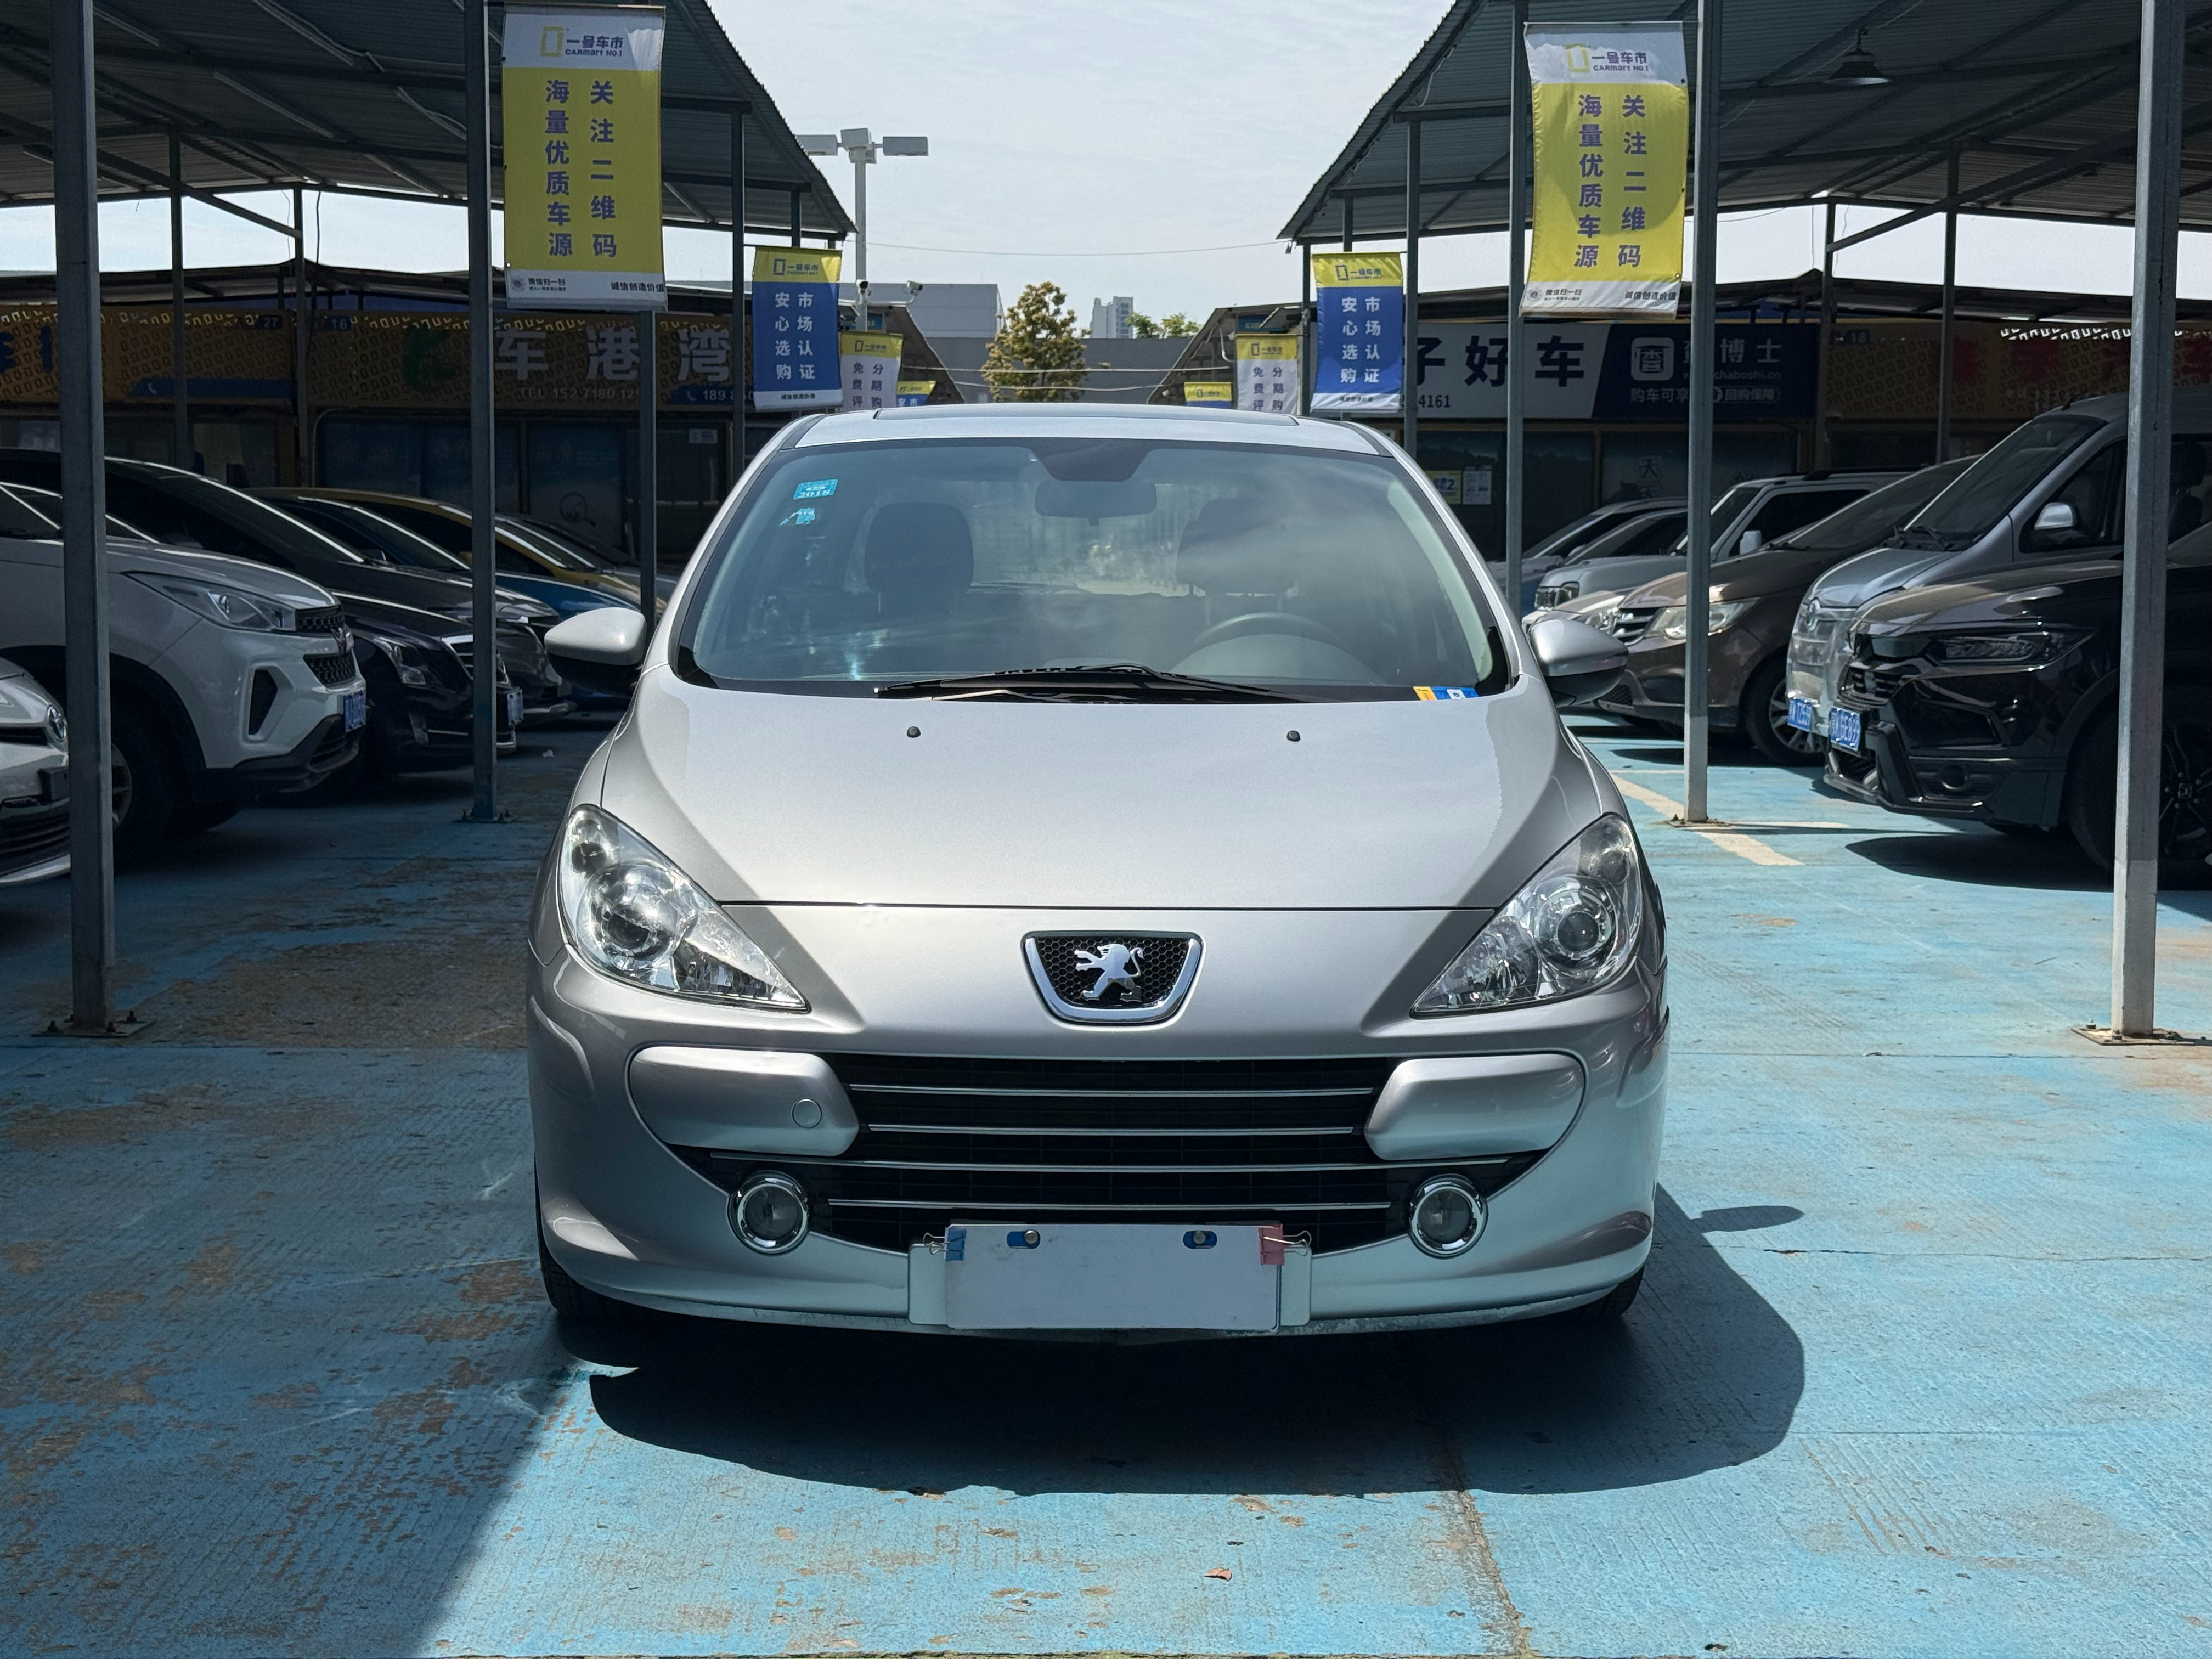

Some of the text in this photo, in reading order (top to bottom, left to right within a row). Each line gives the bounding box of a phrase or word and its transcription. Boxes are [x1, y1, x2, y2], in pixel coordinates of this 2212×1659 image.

[566, 35, 623, 49] 一号车市
[1591, 52, 1647, 64] 一号车市
[545, 80, 573, 257] 海量优质车源
[590, 81, 617, 257] 关注二维码
[1573, 94, 1604, 268] 海量优质车源
[1618, 95, 1647, 268] 关注二维码
[611, 281, 665, 292] 诚信创造价值
[495, 328, 730, 381] 车港湾
[775, 292, 792, 380] 安心选购
[797, 292, 816, 380] 市场认证
[1340, 297, 1358, 383] 安心选购
[1364, 296, 1381, 383] 市场认证
[1682, 369, 1781, 380] wchaboshi.cn
[1683, 338, 1782, 363] 博士
